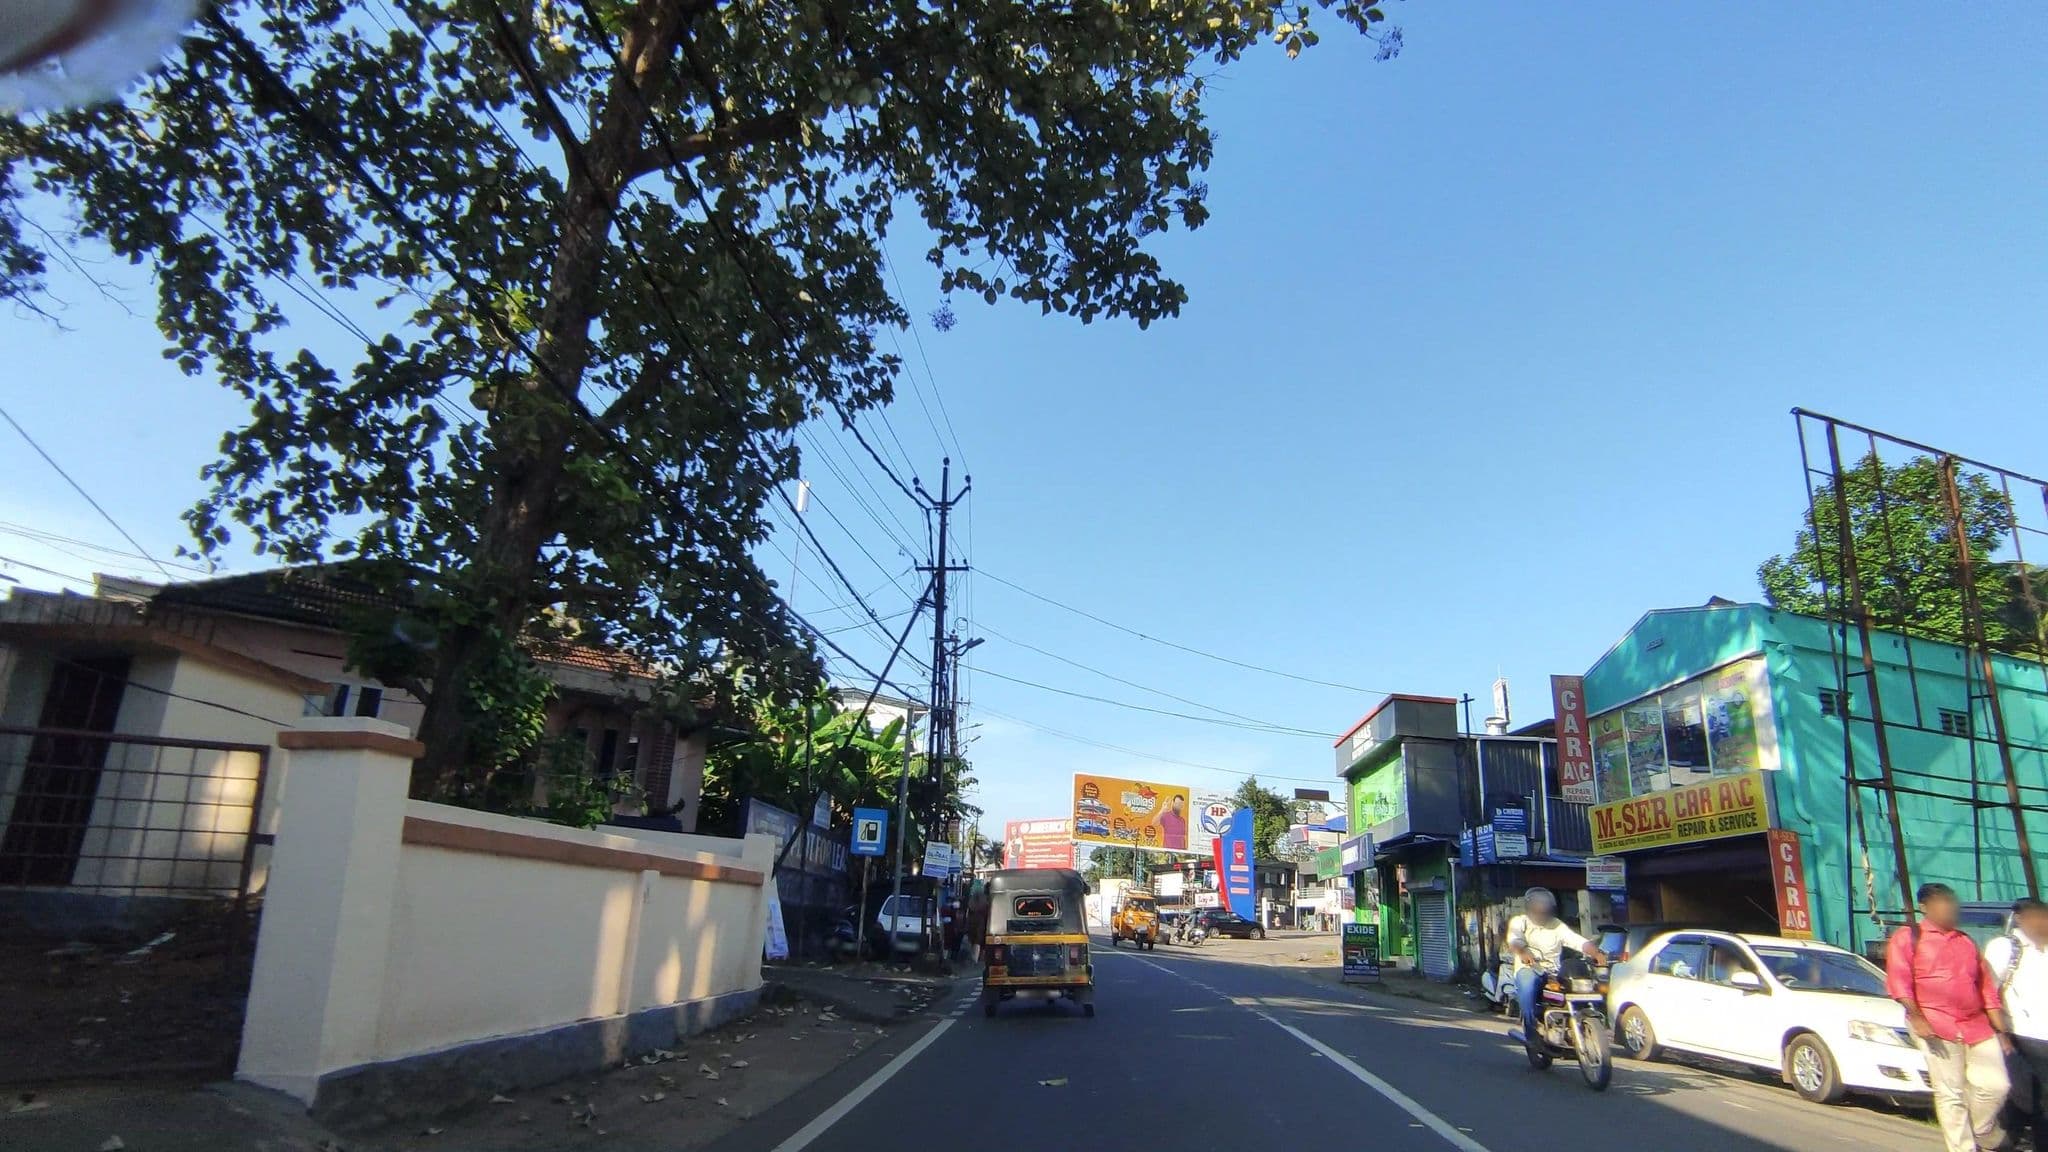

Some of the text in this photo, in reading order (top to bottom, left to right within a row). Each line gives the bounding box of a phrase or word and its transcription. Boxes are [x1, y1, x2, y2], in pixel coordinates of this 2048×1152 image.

[1561, 690, 1583, 757] CAR
[1565, 794, 1593, 803] SERVICE
[1566, 787, 1591, 796] REPAIR
[1211, 807, 1227, 817] HP
[1595, 796, 1671, 839] M-SER
[1674, 786, 1713, 818] CAR
[1677, 812, 1758, 838] REPAIR & SERVICE
[1780, 843, 1800, 906] CAR
[1347, 925, 1375, 935] EXIDE
